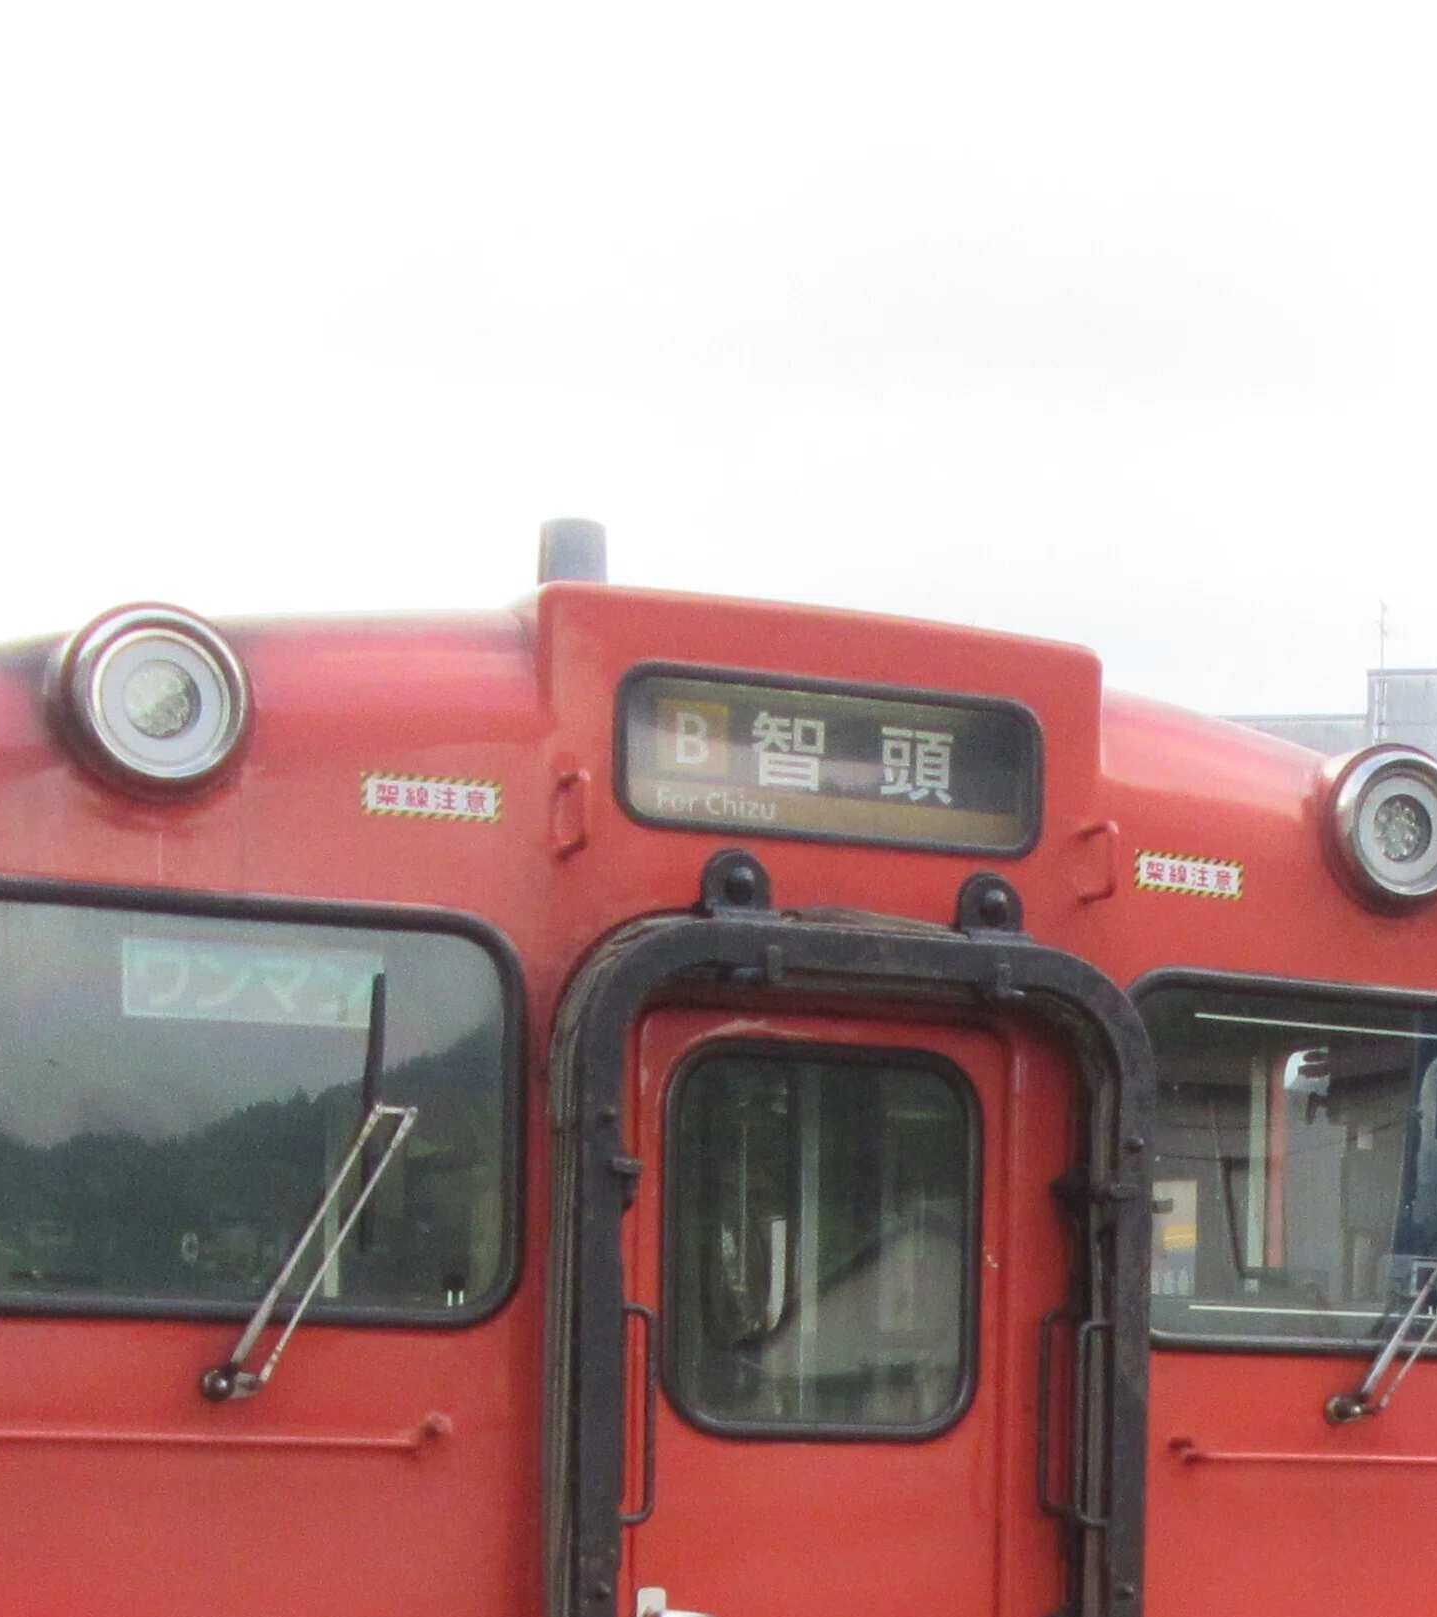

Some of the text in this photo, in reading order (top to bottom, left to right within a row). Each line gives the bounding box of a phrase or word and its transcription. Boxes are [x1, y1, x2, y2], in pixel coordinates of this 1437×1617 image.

[675, 711, 709, 766] B
[751, 711, 955, 805] 智頭
[375, 783, 488, 815] 架線注意
[655, 786, 777, 820] For Chizu
[1145, 860, 1233, 892] 架線注意
